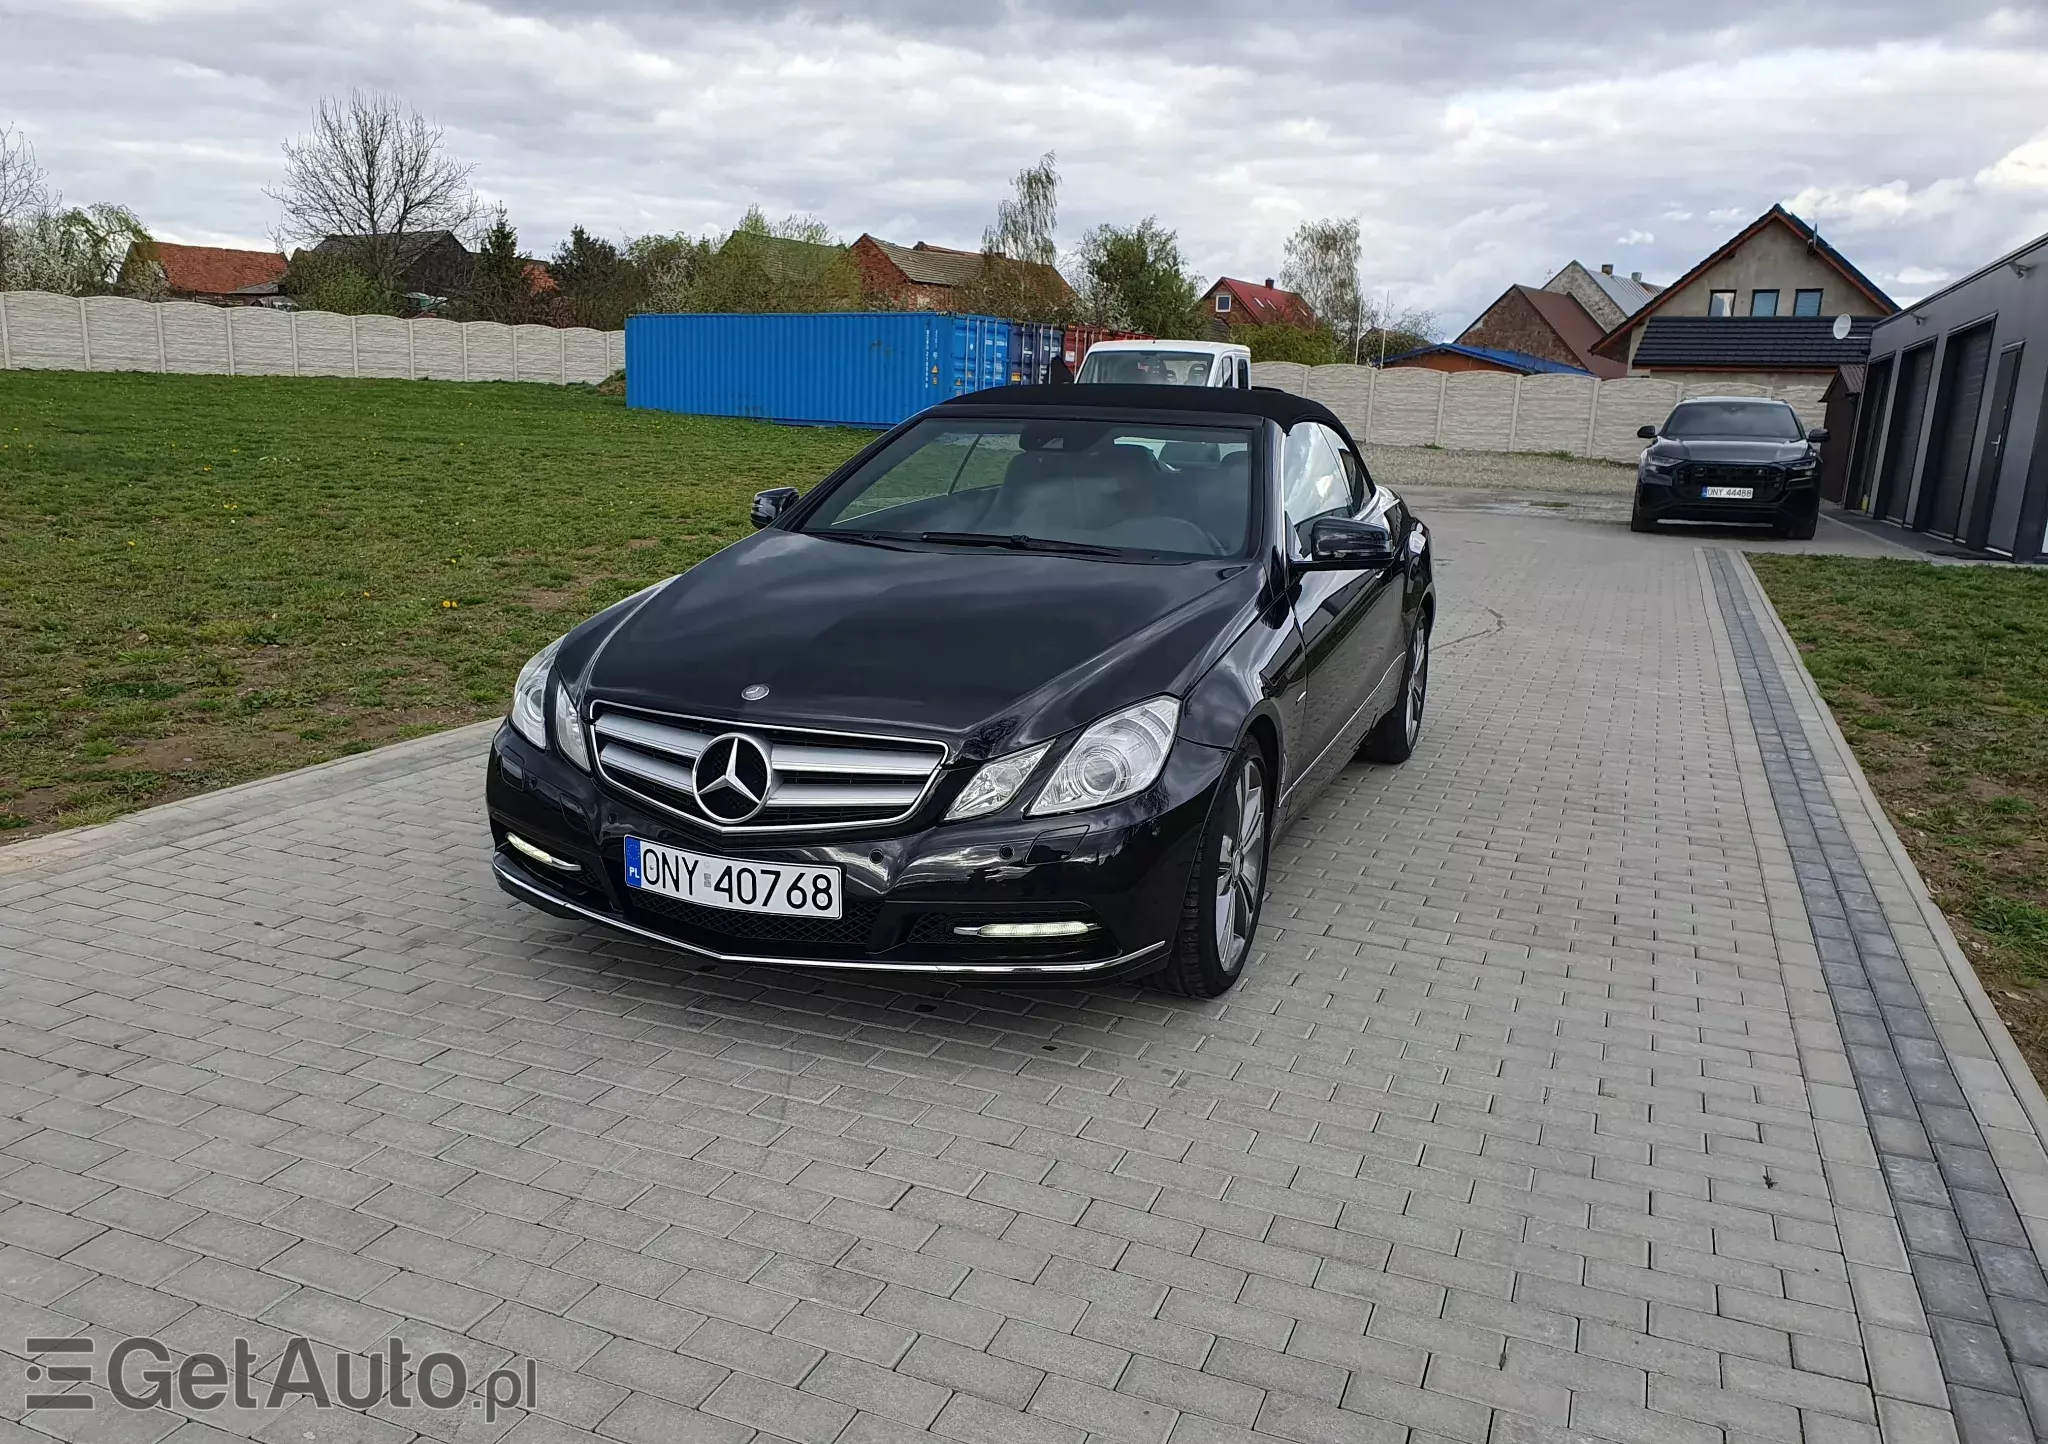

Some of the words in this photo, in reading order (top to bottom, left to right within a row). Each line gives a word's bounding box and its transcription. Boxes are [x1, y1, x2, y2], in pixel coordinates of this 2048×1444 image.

[629, 866, 640, 879] PL
[642, 848, 699, 896] ONY
[713, 865, 833, 911] 40768
